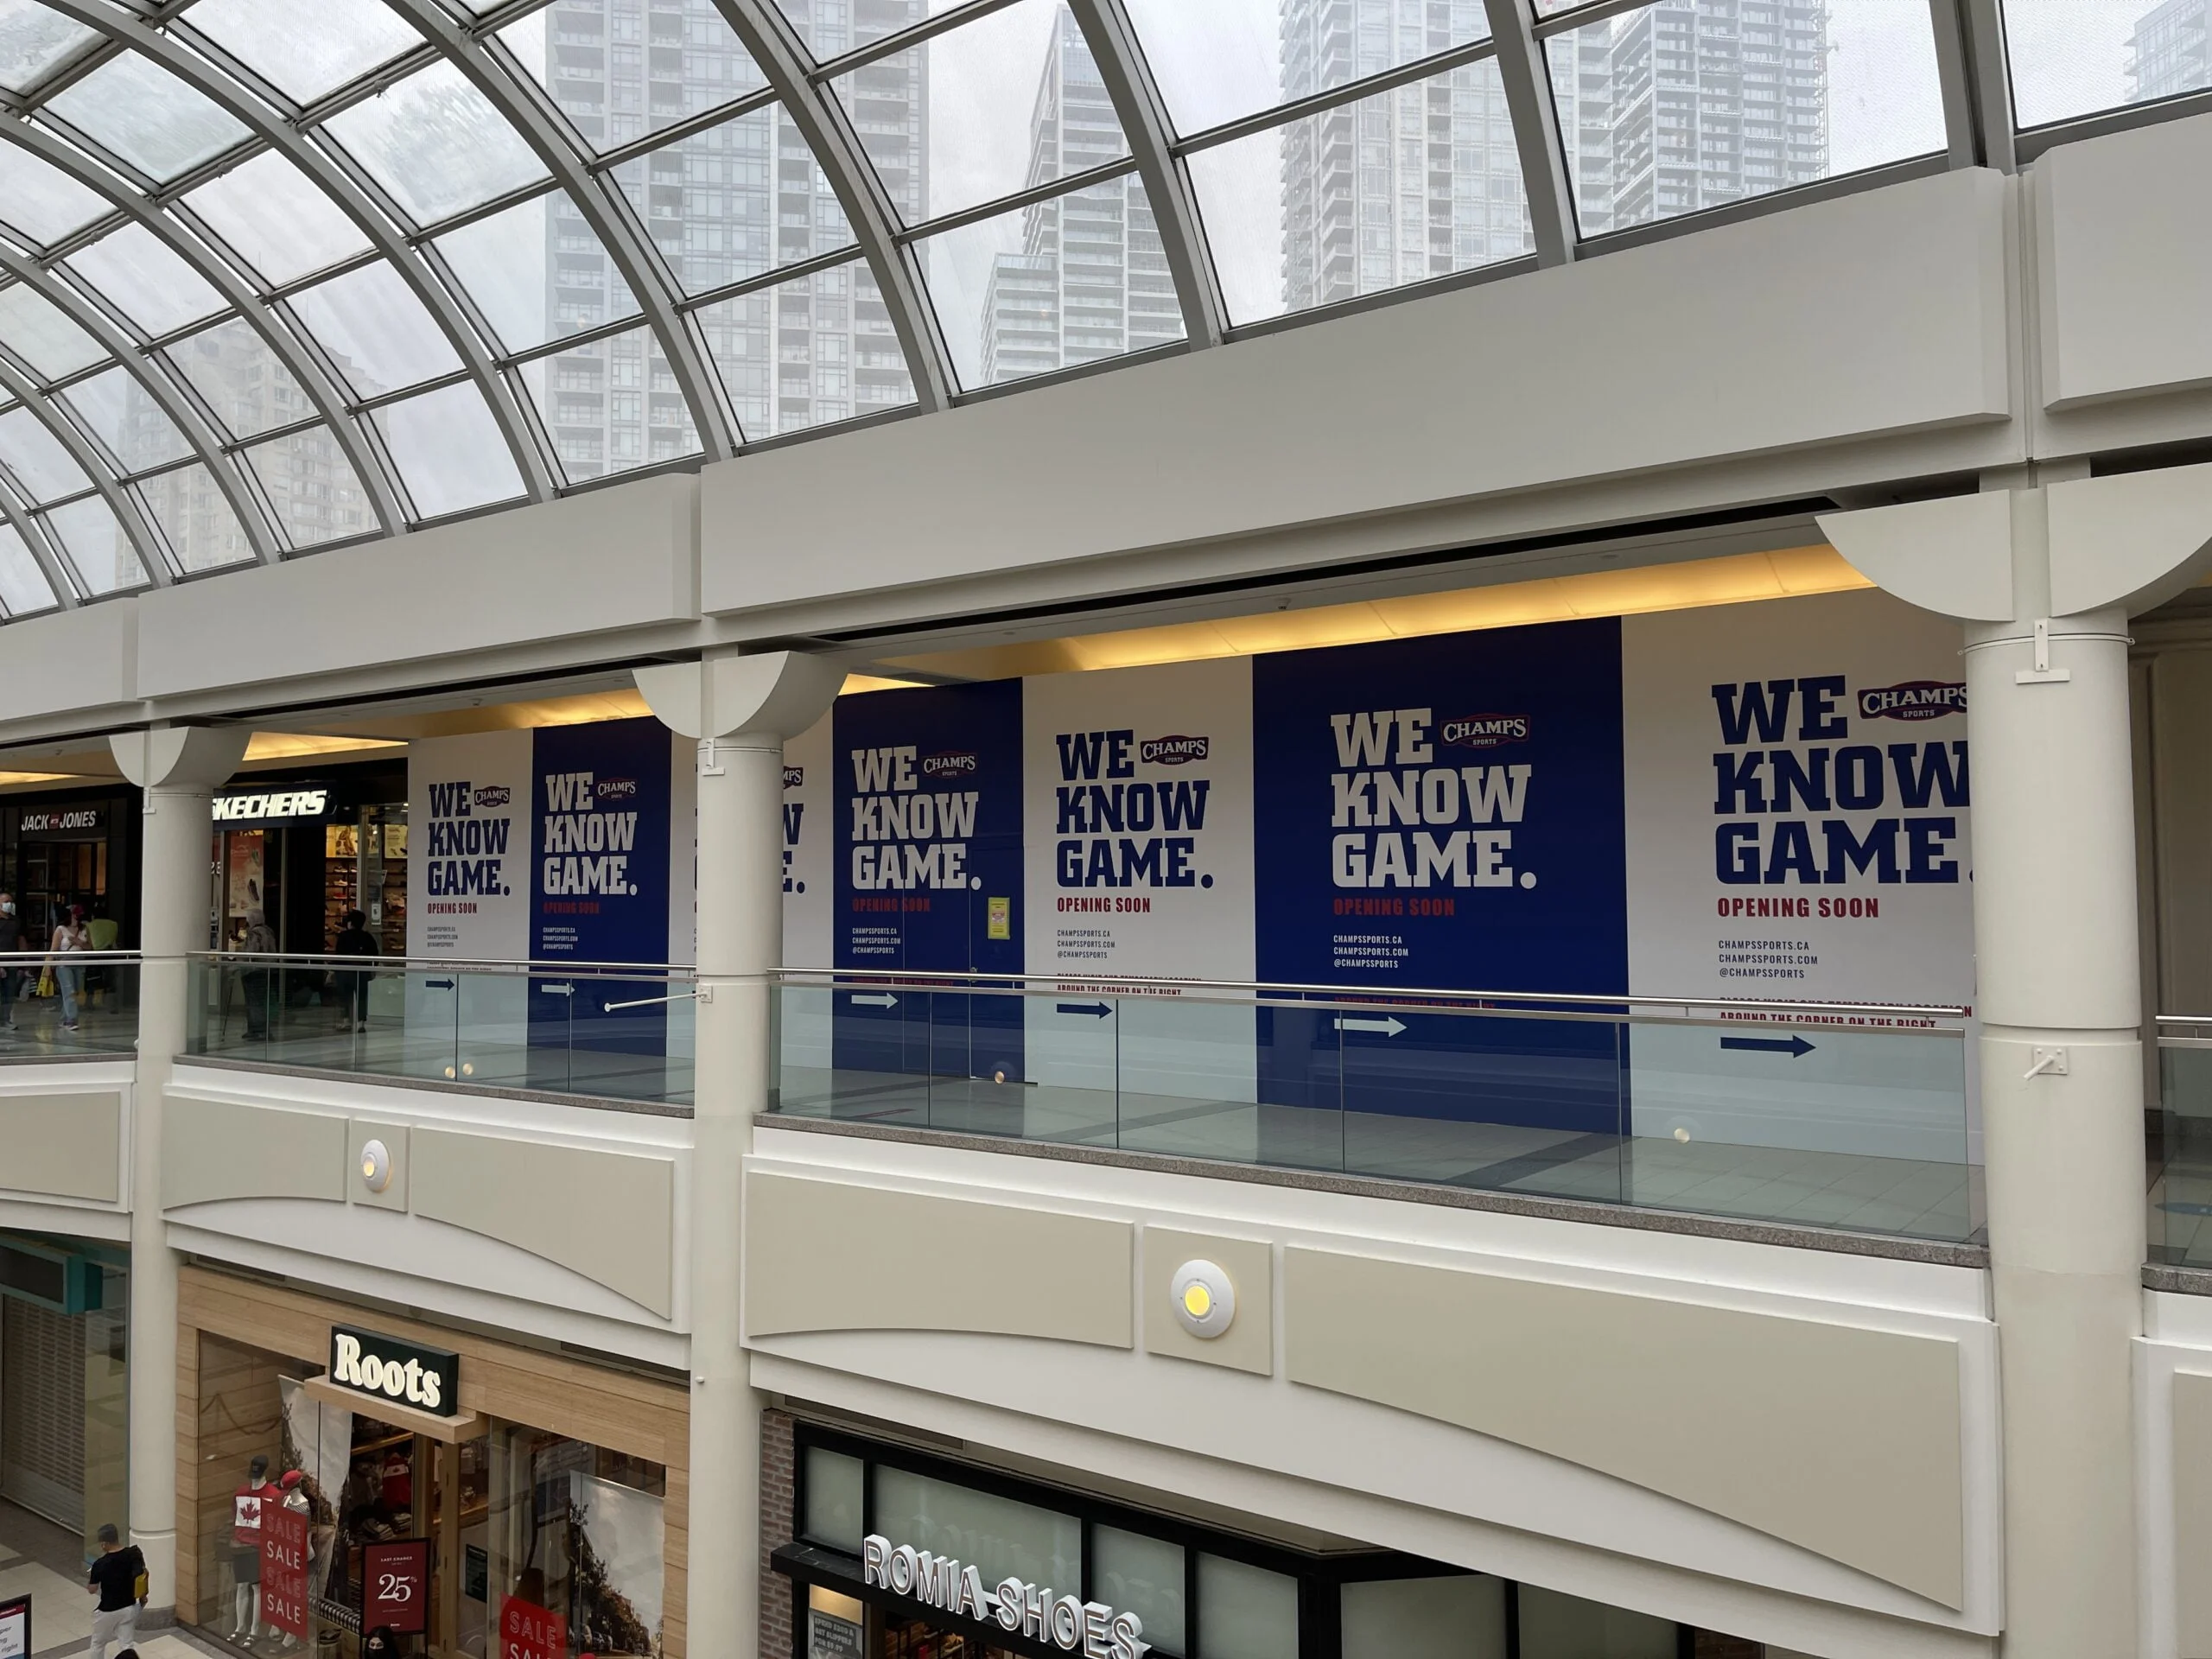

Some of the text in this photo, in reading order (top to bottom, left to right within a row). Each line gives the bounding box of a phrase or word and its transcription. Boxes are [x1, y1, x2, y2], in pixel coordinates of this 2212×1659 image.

[1712, 674, 1848, 746] WE
[1903, 709, 1935, 718] SPORTS
[1330, 708, 1433, 767] WE
[1443, 718, 1527, 742] CHAMPS
[924, 755, 976, 773] CHAMPS
[1056, 729, 1135, 781] WE
[1142, 740, 1206, 760] CHAMPS
[851, 746, 918, 793] WE
[1713, 741, 1970, 815] KNOW
[429, 781, 471, 817] WE
[475, 789, 509, 803] CHAMPS
[545, 772, 594, 811] WE
[598, 781, 636, 796] CHAMPS
[1332, 764, 1532, 827] KNOW
[22, 814, 49, 830] JACK
[60, 810, 96, 829] JONES
[852, 791, 979, 841] KNOW
[1056, 780, 1210, 834] KNOW
[428, 818, 510, 856] KNOW
[544, 812, 638, 853] KNOW
[1057, 837, 1213, 889] GAME.
[1332, 830, 1537, 889] GAME.
[1715, 817, 1973, 885] GAME
[428, 859, 510, 896] GAME.
[543, 855, 638, 896] GAME.
[852, 843, 982, 891] GAME.
[427, 903, 477, 914] OPENING SOON
[852, 897, 931, 912] OPENING SOON
[1057, 897, 1151, 913] OPENING SOON
[1333, 898, 1455, 917] OPENING SOON
[1718, 898, 1879, 918] OPENING SOON
[1333, 935, 1402, 944] CHAMPSSPORTS.CA
[1333, 947, 1408, 957] CHAMPSSPORTS.COM
[1719, 940, 1809, 950] CHAMPSSPORTS.CA
[1334, 958, 1398, 968] @CHAMPSSPORTS
[1719, 954, 1818, 965] CHAMPSSPORTS.COM
[1719, 968, 1804, 978] @CHAMPSSPORTS
[1720, 1012, 1767, 1020] AROUND
[1770, 1014, 1792, 1022] THE
[1796, 1014, 1844, 1024] CORNER
[334, 1333, 441, 1408] Roots
[266, 1513, 300, 1543] SALE
[267, 1541, 300, 1570] SALE
[266, 1567, 301, 1599] SALE
[864, 1535, 1143, 1659] ROMIA SHOES
[267, 1593, 301, 1624] SALE
[510, 1611, 556, 1649] SALE
